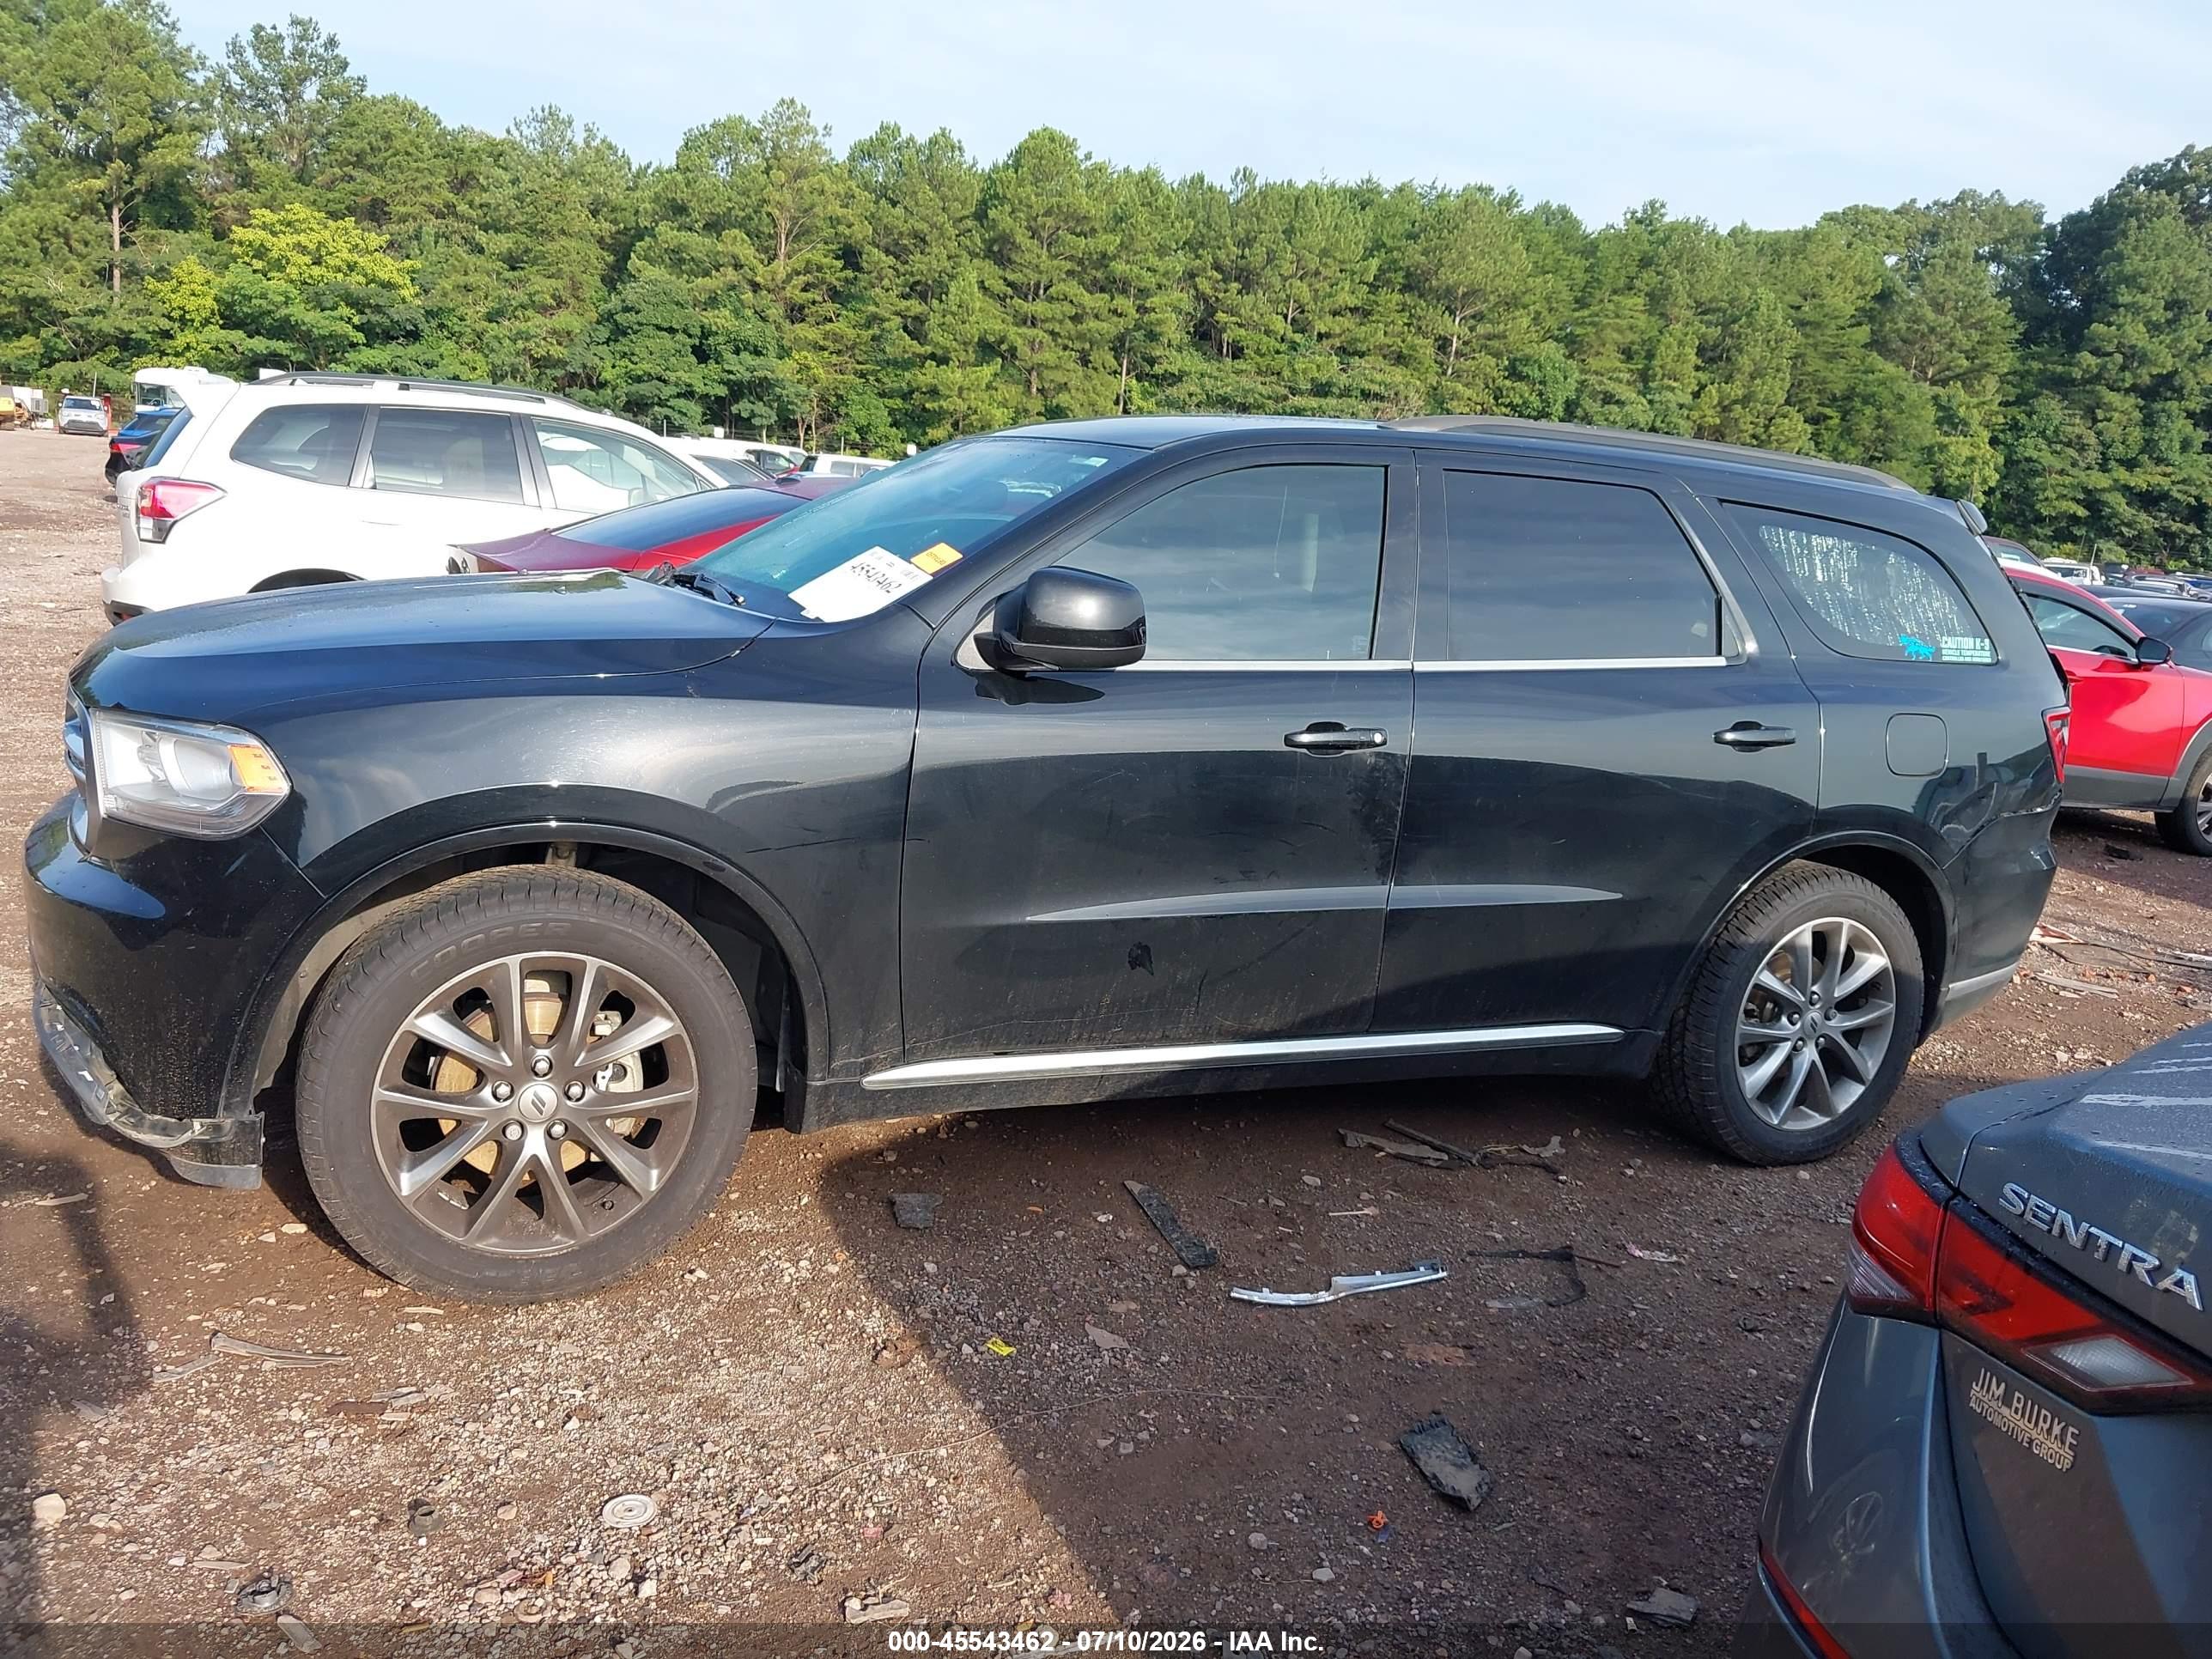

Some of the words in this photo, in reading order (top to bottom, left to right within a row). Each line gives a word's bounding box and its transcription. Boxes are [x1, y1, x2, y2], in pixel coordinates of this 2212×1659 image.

[1942, 636, 1974, 649] CAUTION
[410, 922, 572, 978] COOPER
[1998, 1182, 2204, 1312] SENTRA
[1969, 1395, 2032, 1448] AUTOMOTIVE
[2033, 1439, 2072, 1472] GROUP
[1972, 1367, 2006, 1408] JIM
[2010, 1391, 2080, 1456] BURKE
